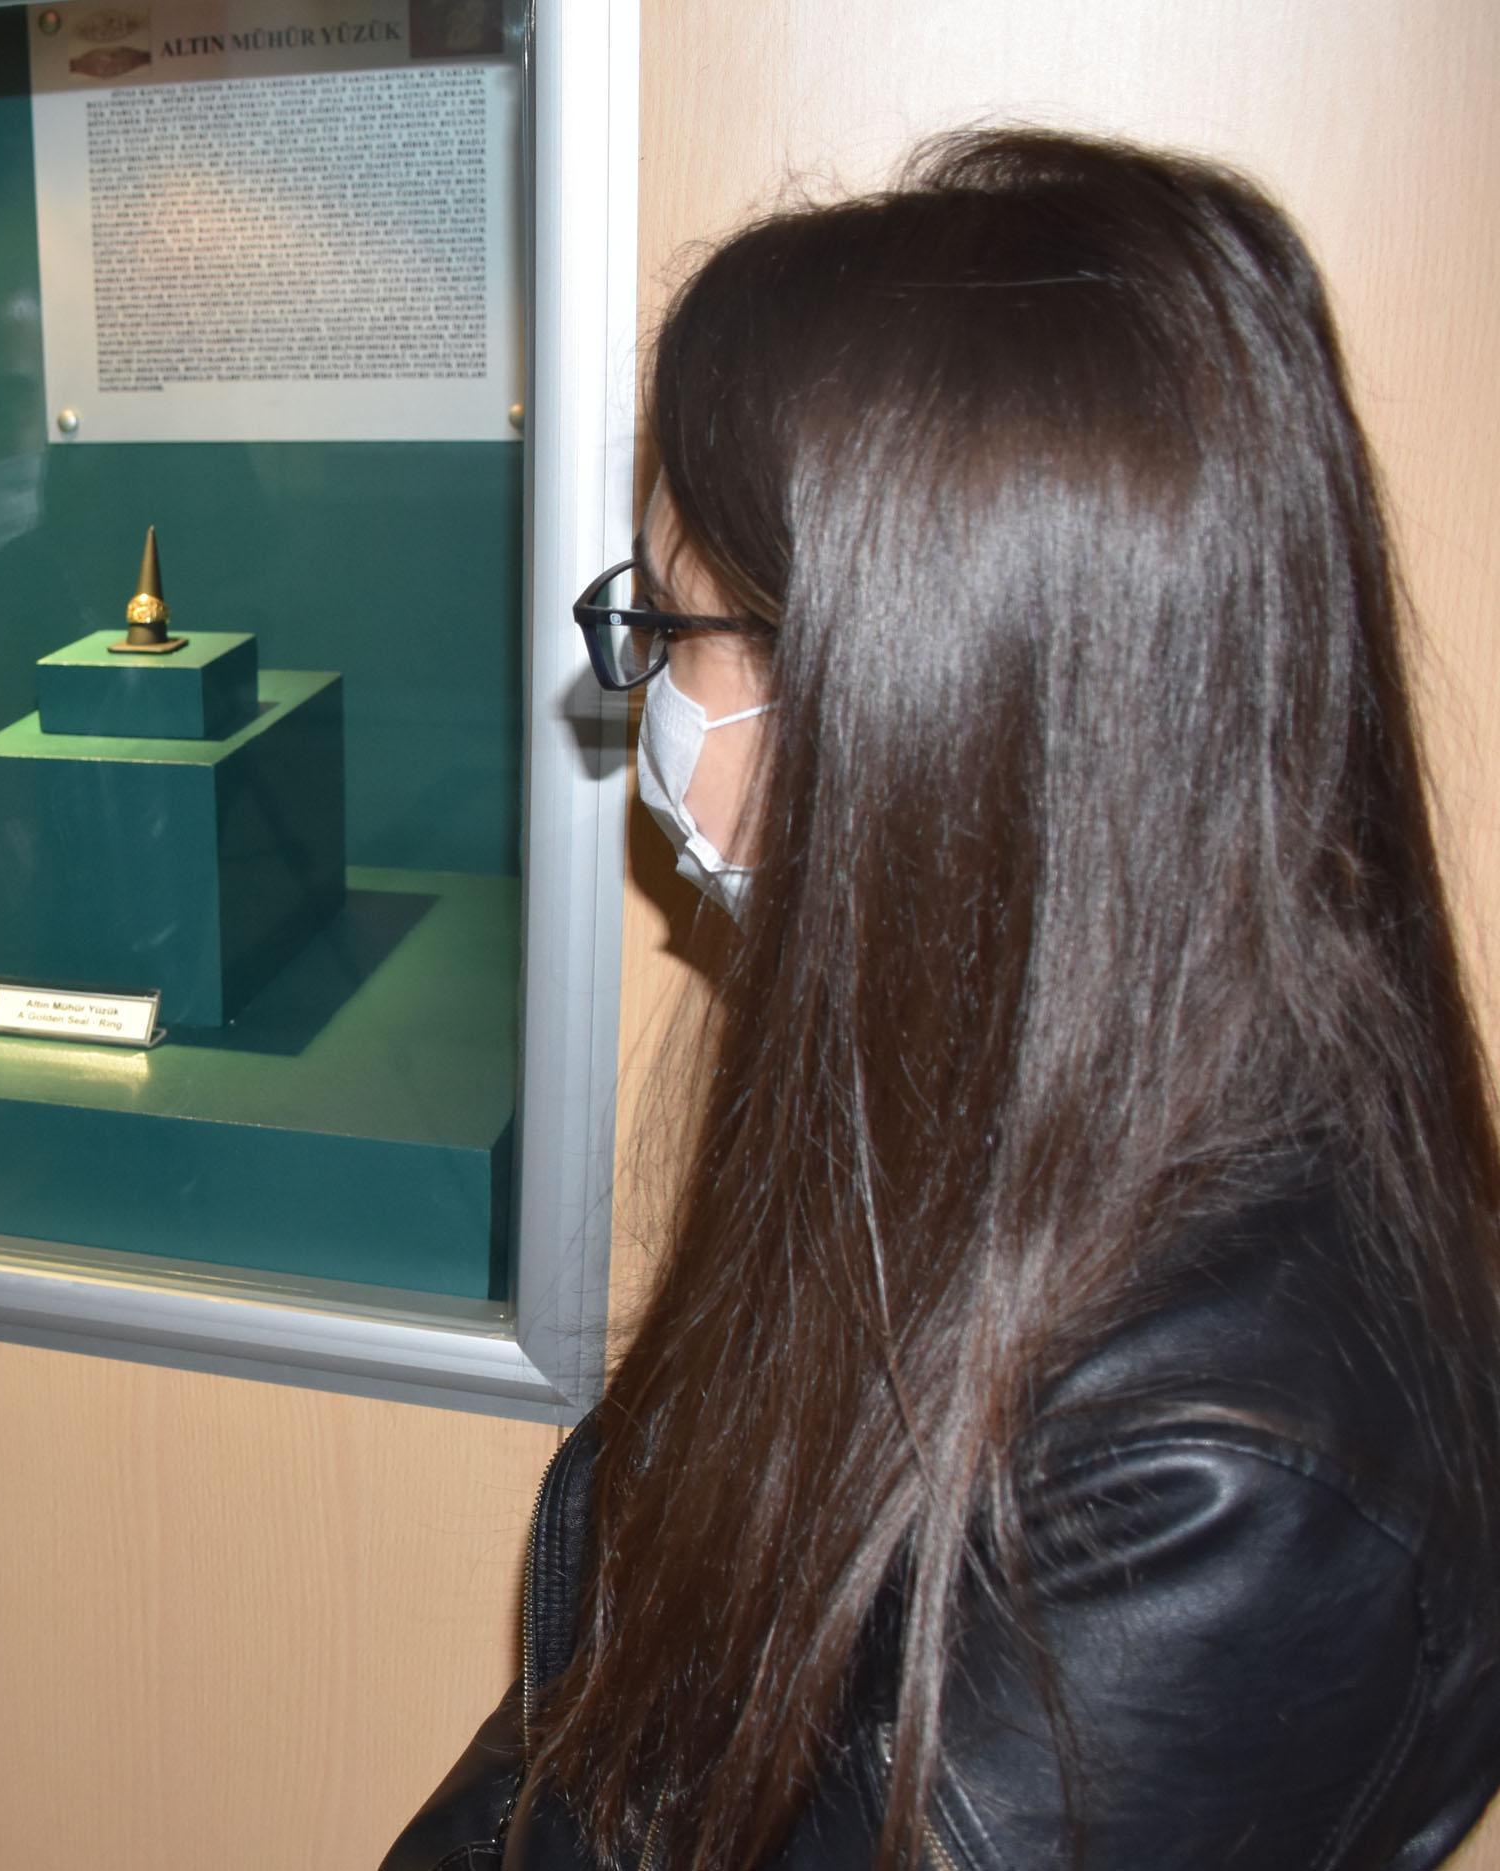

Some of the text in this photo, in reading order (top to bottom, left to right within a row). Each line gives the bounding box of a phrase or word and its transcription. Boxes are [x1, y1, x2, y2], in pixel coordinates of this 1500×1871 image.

[161, 20, 402, 57] ALTIN MÜHÜR YÜZÜK
[28, 1012, 64, 1024] Golden
[67, 1015, 90, 1025] Seal
[99, 1018, 123, 1031] Ring
